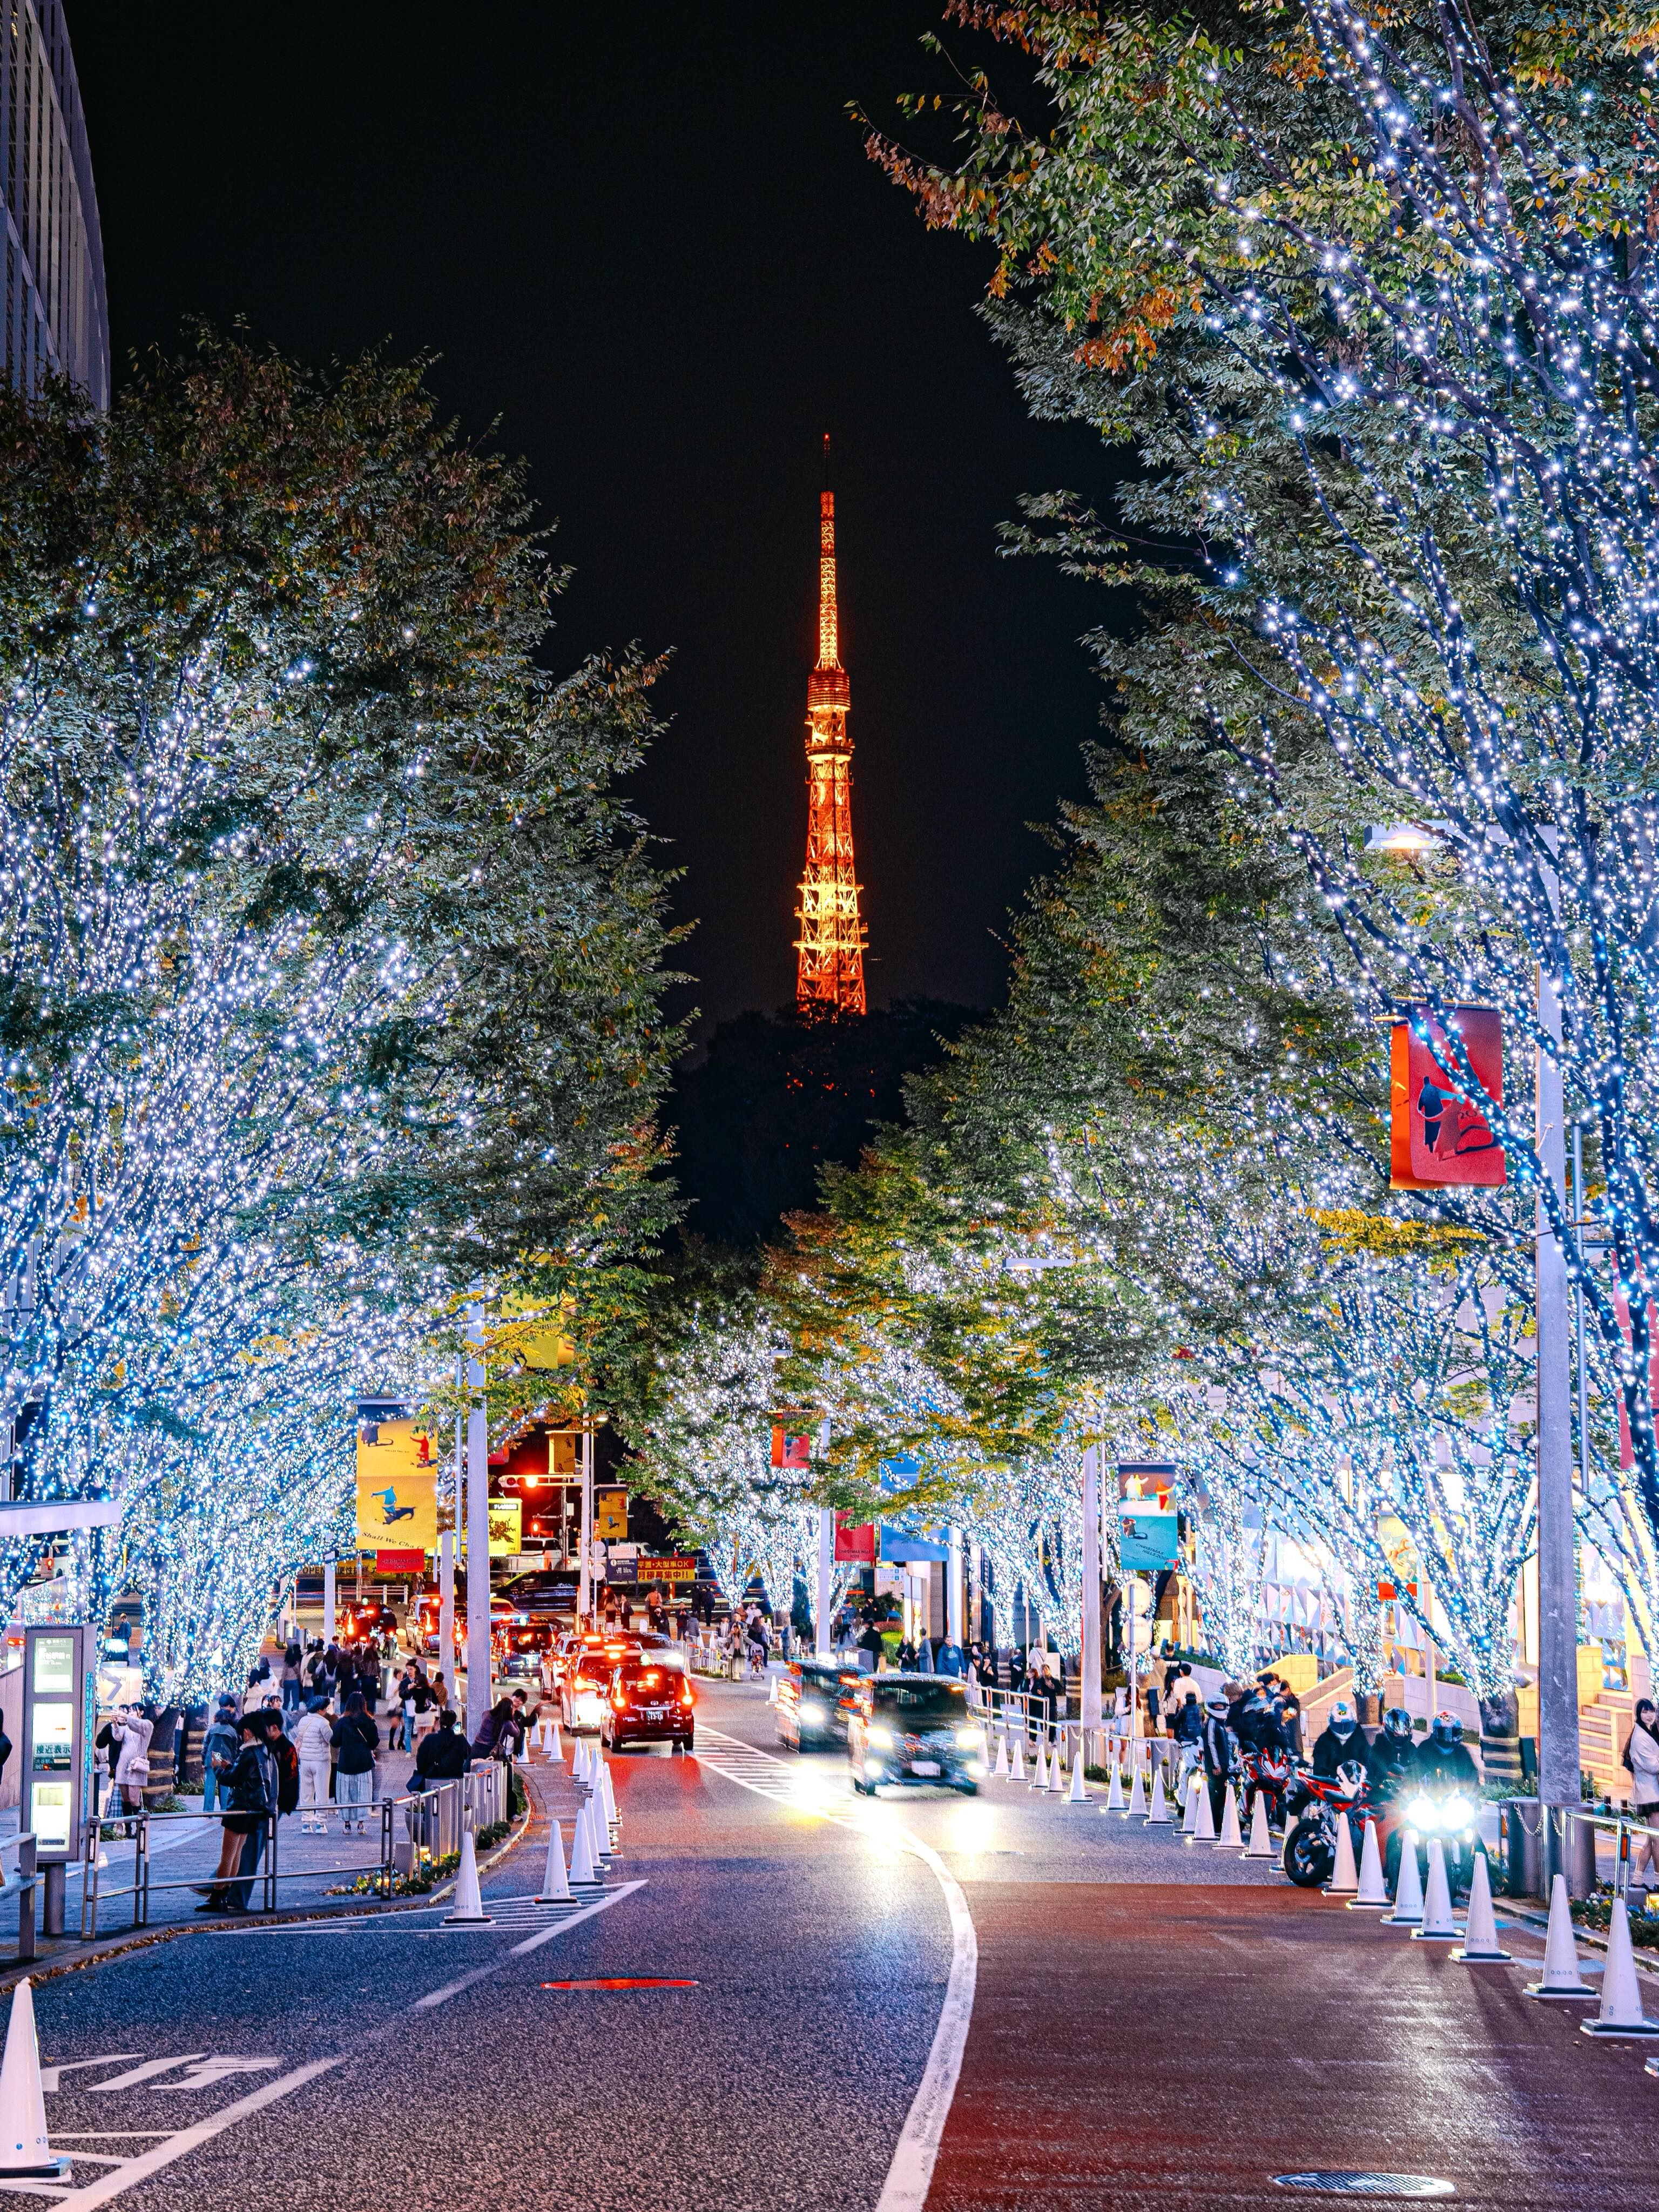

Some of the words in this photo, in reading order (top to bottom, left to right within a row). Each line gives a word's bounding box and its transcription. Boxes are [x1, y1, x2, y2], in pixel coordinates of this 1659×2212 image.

[362, 1532, 383, 1541] Shall
[1135, 1543, 1164, 1555] CHRISTMAS
[36, 1744, 70, 1754] 接近表示
